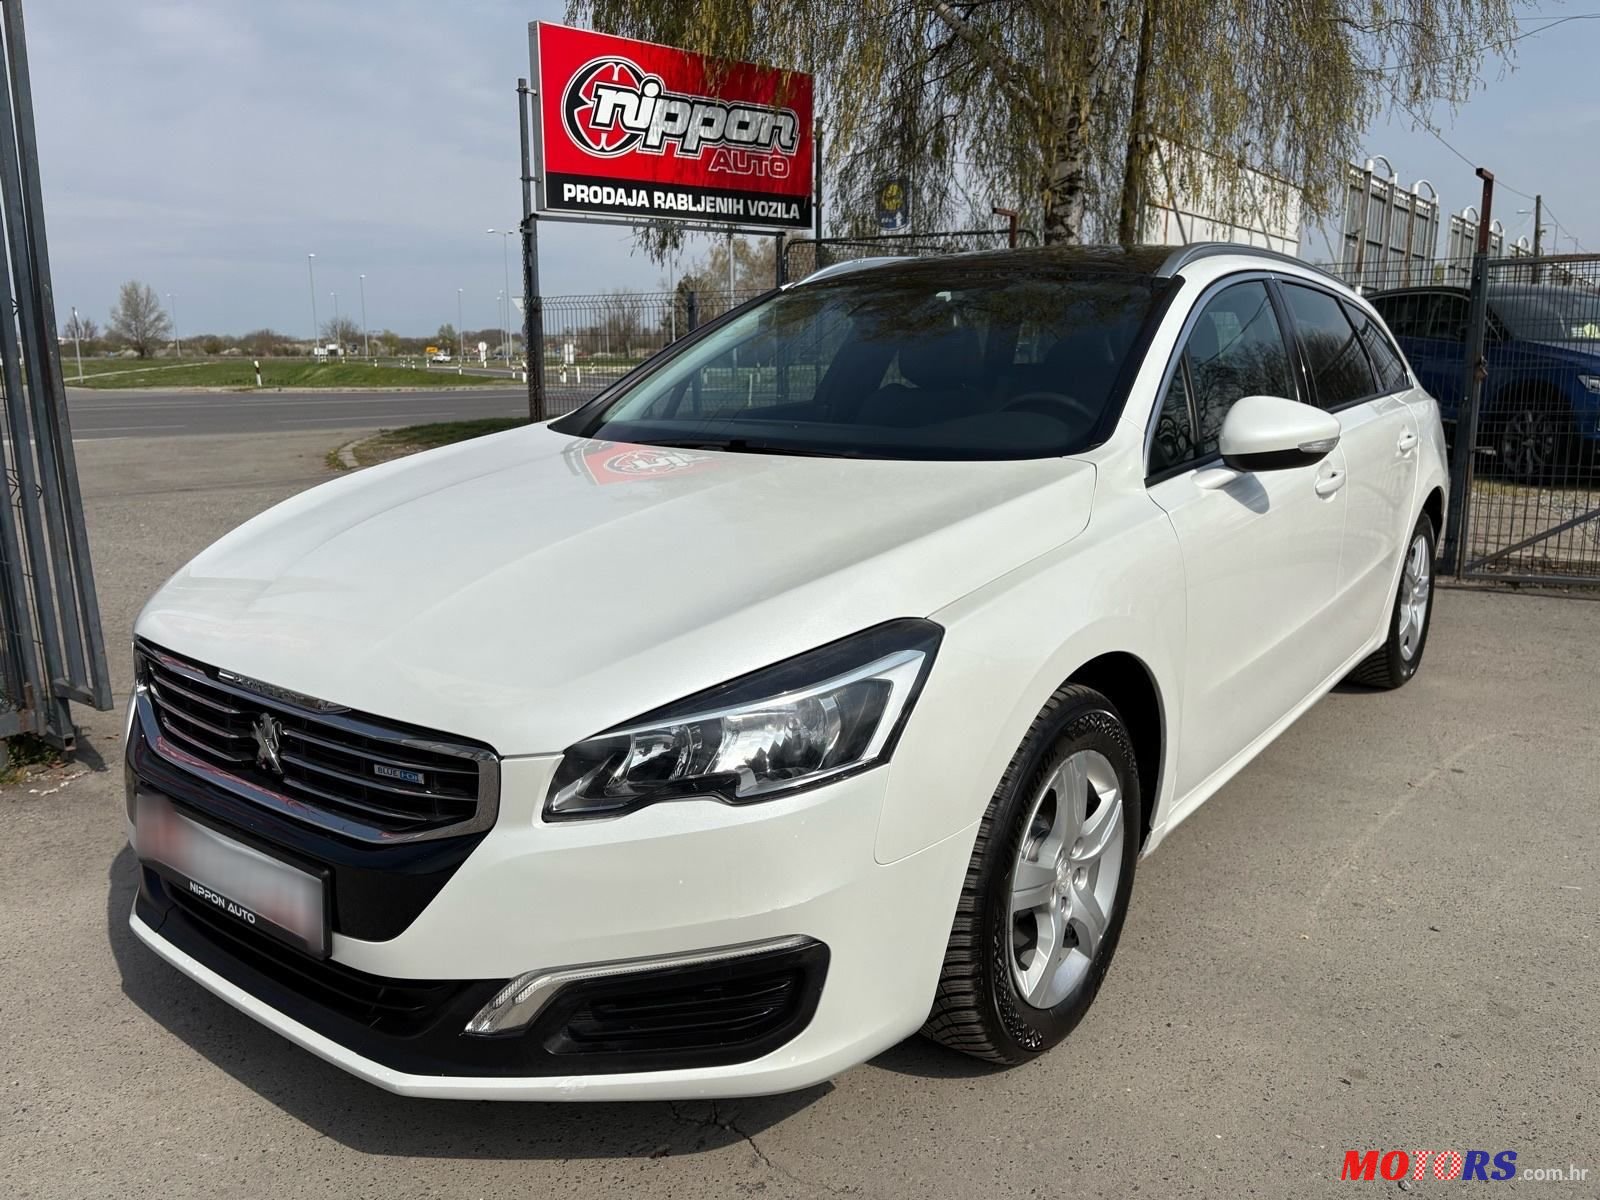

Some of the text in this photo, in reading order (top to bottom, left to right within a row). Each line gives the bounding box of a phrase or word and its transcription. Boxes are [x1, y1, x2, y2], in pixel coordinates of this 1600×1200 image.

[594, 80, 796, 151] nippon
[708, 149, 790, 179] AUTO
[563, 183, 800, 220] PRODAJA RABLJENIH VOZILA
[189, 880, 257, 925] NIPPON AUTO
